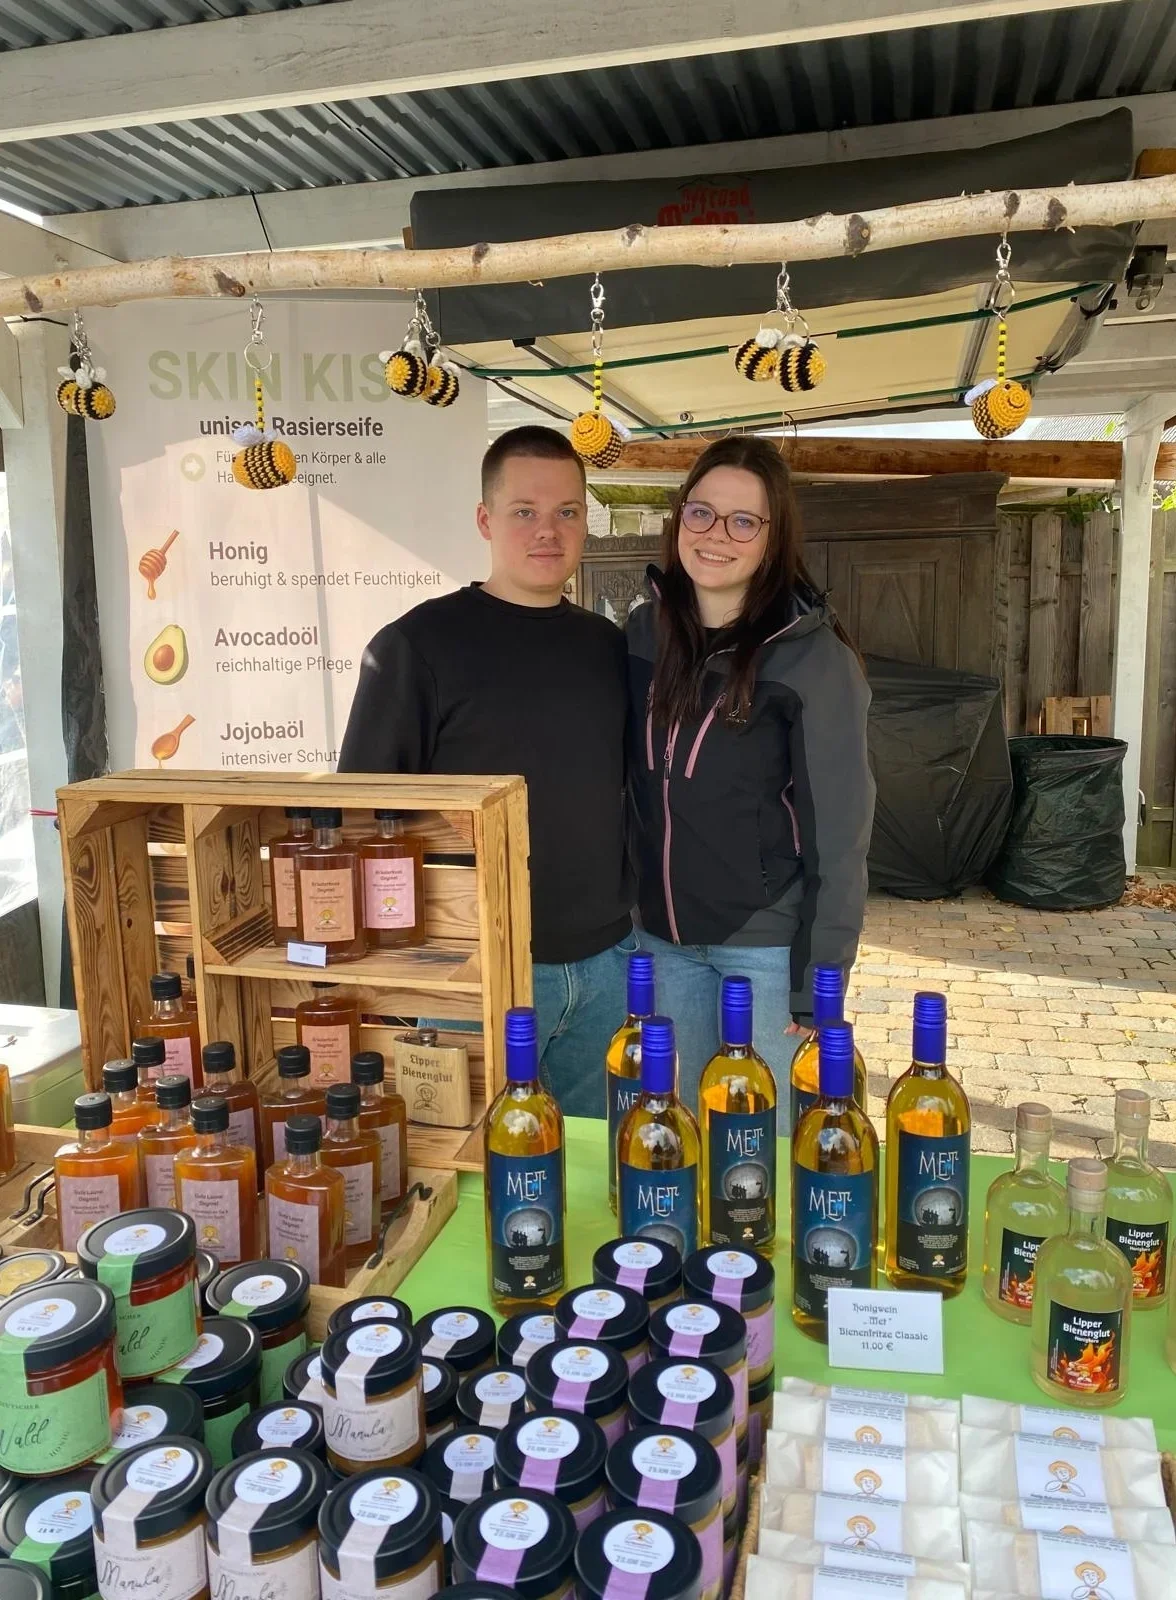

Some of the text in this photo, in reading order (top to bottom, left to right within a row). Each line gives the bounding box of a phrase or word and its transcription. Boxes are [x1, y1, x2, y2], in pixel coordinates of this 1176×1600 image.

[147, 350, 422, 402] SKIN KIS
[272, 417, 384, 437] Rasierseife
[312, 451, 351, 466] Körper
[354, 453, 364, 464] &
[366, 452, 386, 465] alle
[209, 541, 268, 564] Honig
[210, 570, 441, 589] beruhigt & spendet Feuchtigkeit
[214, 627, 318, 648] Avocadoöl
[215, 657, 353, 675] reichhaltige Pflege
[220, 720, 304, 745] Jojobaöl
[221, 748, 341, 767] intensiver Schut
[402, 1065, 453, 1083] Bienenglut
[616, 1089, 642, 1112] ME
[727, 1127, 764, 1157] MET
[918, 1151, 959, 1181] MET
[506, 1170, 547, 1201] MET
[638, 1184, 680, 1217] MET
[808, 1186, 853, 1222] MET
[1118, 1235, 1160, 1248] Bienenglut
[1128, 1228, 1154, 1239] Lipper
[852, 1302, 898, 1315] Honigwein
[1063, 1322, 1111, 1339] Bienenglut
[1073, 1316, 1103, 1329] Lipper
[886, 1342, 894, 1352] €
